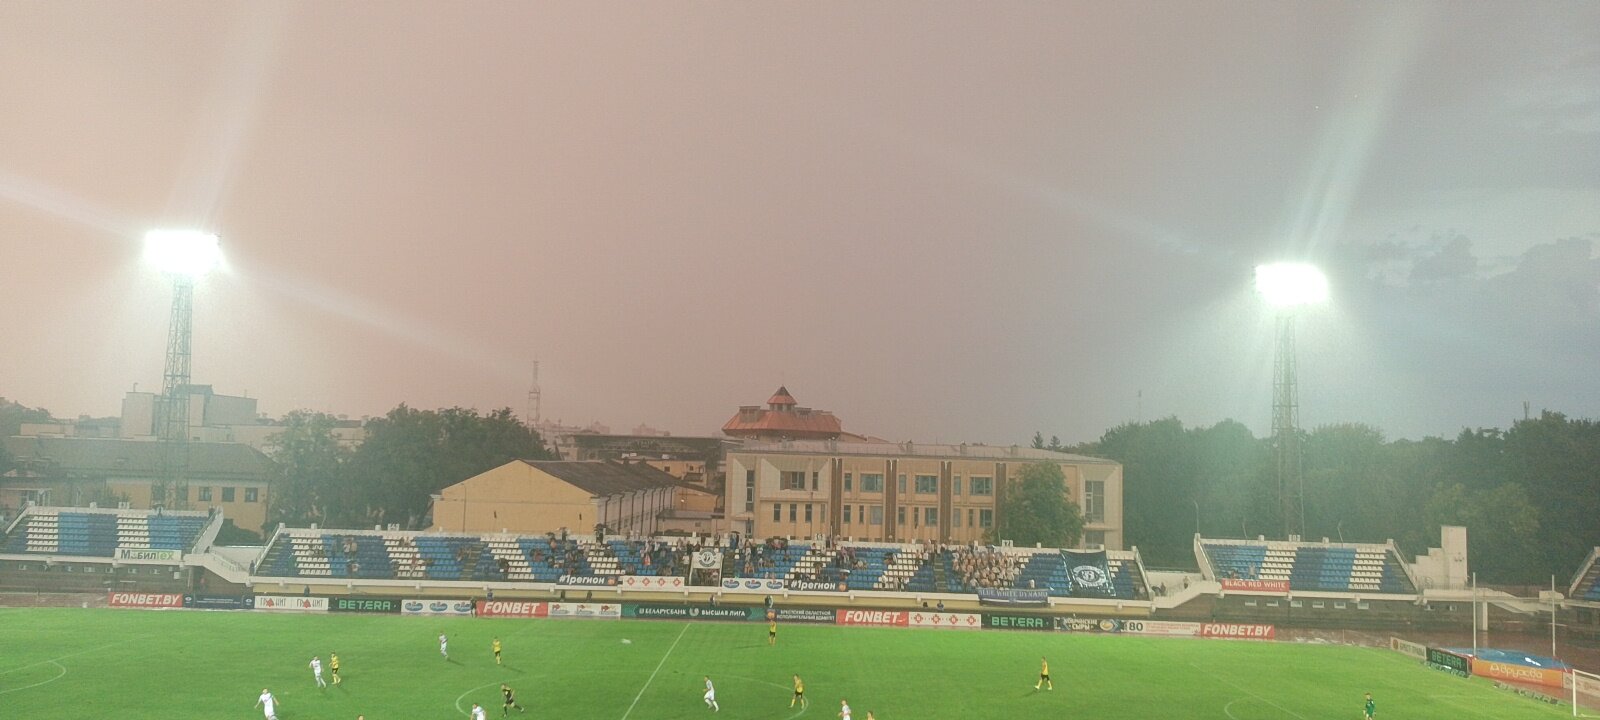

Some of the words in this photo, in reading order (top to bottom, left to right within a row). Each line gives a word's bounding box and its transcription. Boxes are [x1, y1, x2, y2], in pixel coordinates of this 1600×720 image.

[559, 575, 605, 585] #1регион
[790, 580, 836, 590] #1регион
[111, 593, 180, 605] FONBET.BY
[483, 601, 540, 615] FONBET
[645, 607, 687, 615] БЕЛАРУСБАНК
[844, 610, 901, 624] FONBET
[1128, 621, 1144, 632] 80
[1203, 623, 1272, 637] FONBET.BY
